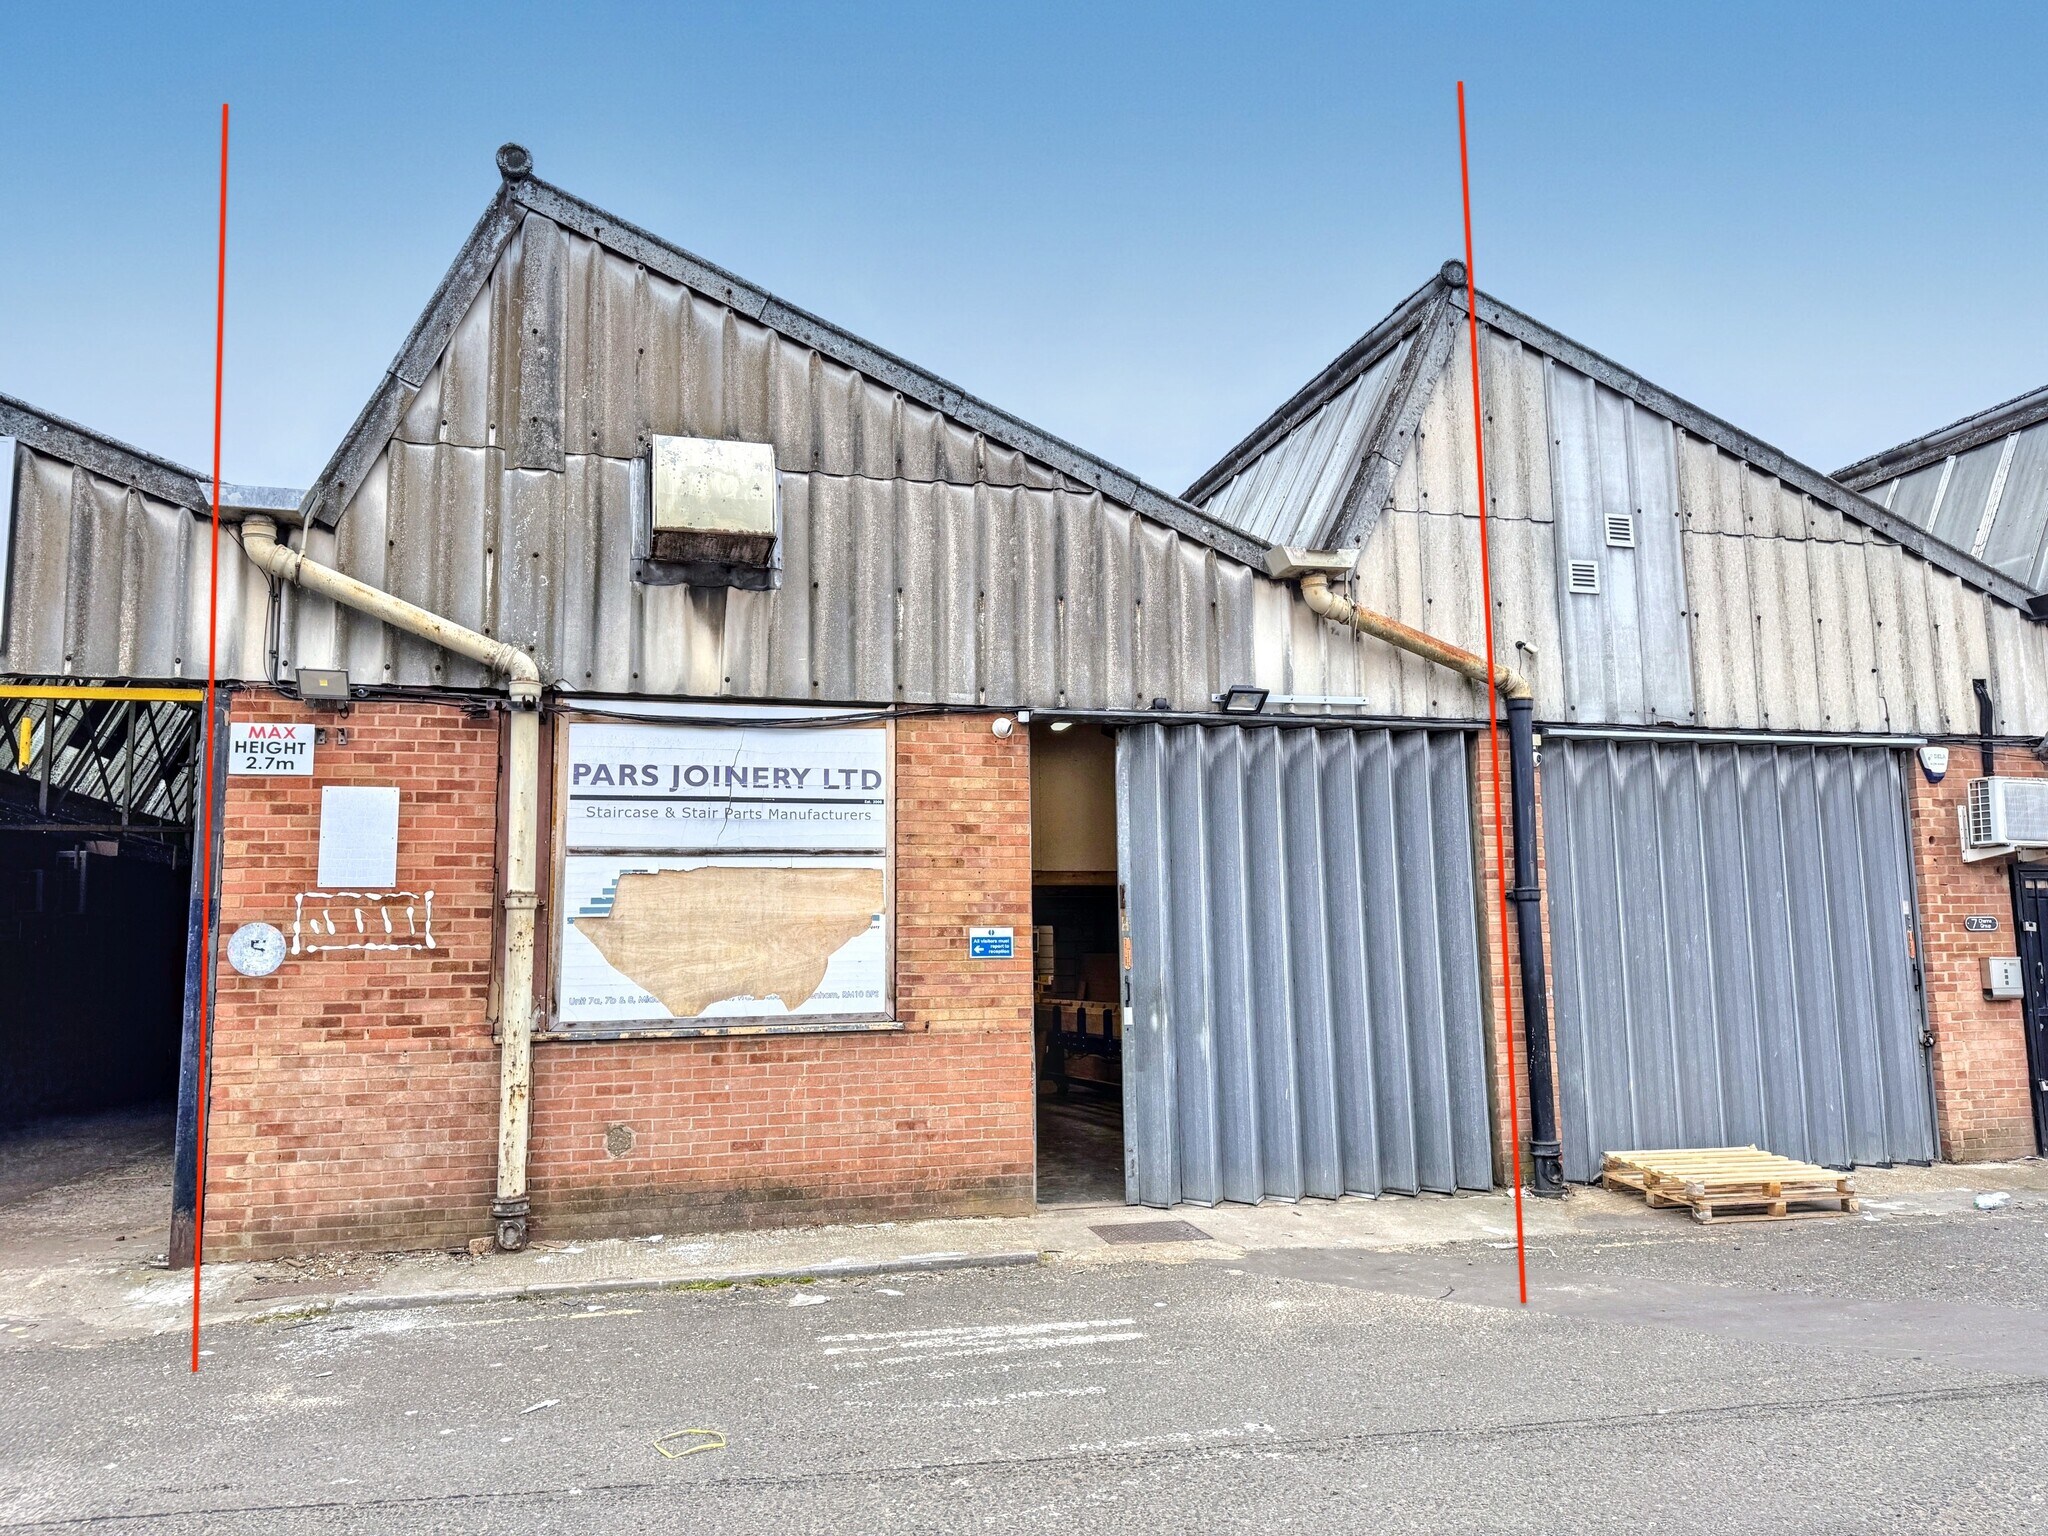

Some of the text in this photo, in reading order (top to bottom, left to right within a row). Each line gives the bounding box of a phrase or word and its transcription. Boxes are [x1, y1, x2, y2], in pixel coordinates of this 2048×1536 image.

[248, 726, 296, 739] MAX
[234, 740, 307, 755] HEIGHT
[246, 756, 294, 770] 2.7m
[573, 763, 882, 792] PARS JOINERY LTD
[586, 806, 872, 821] Staircase & Stair Parts Manufacturers
[1971, 918, 1978, 929] 7
[568, 996, 587, 1005] Unit
